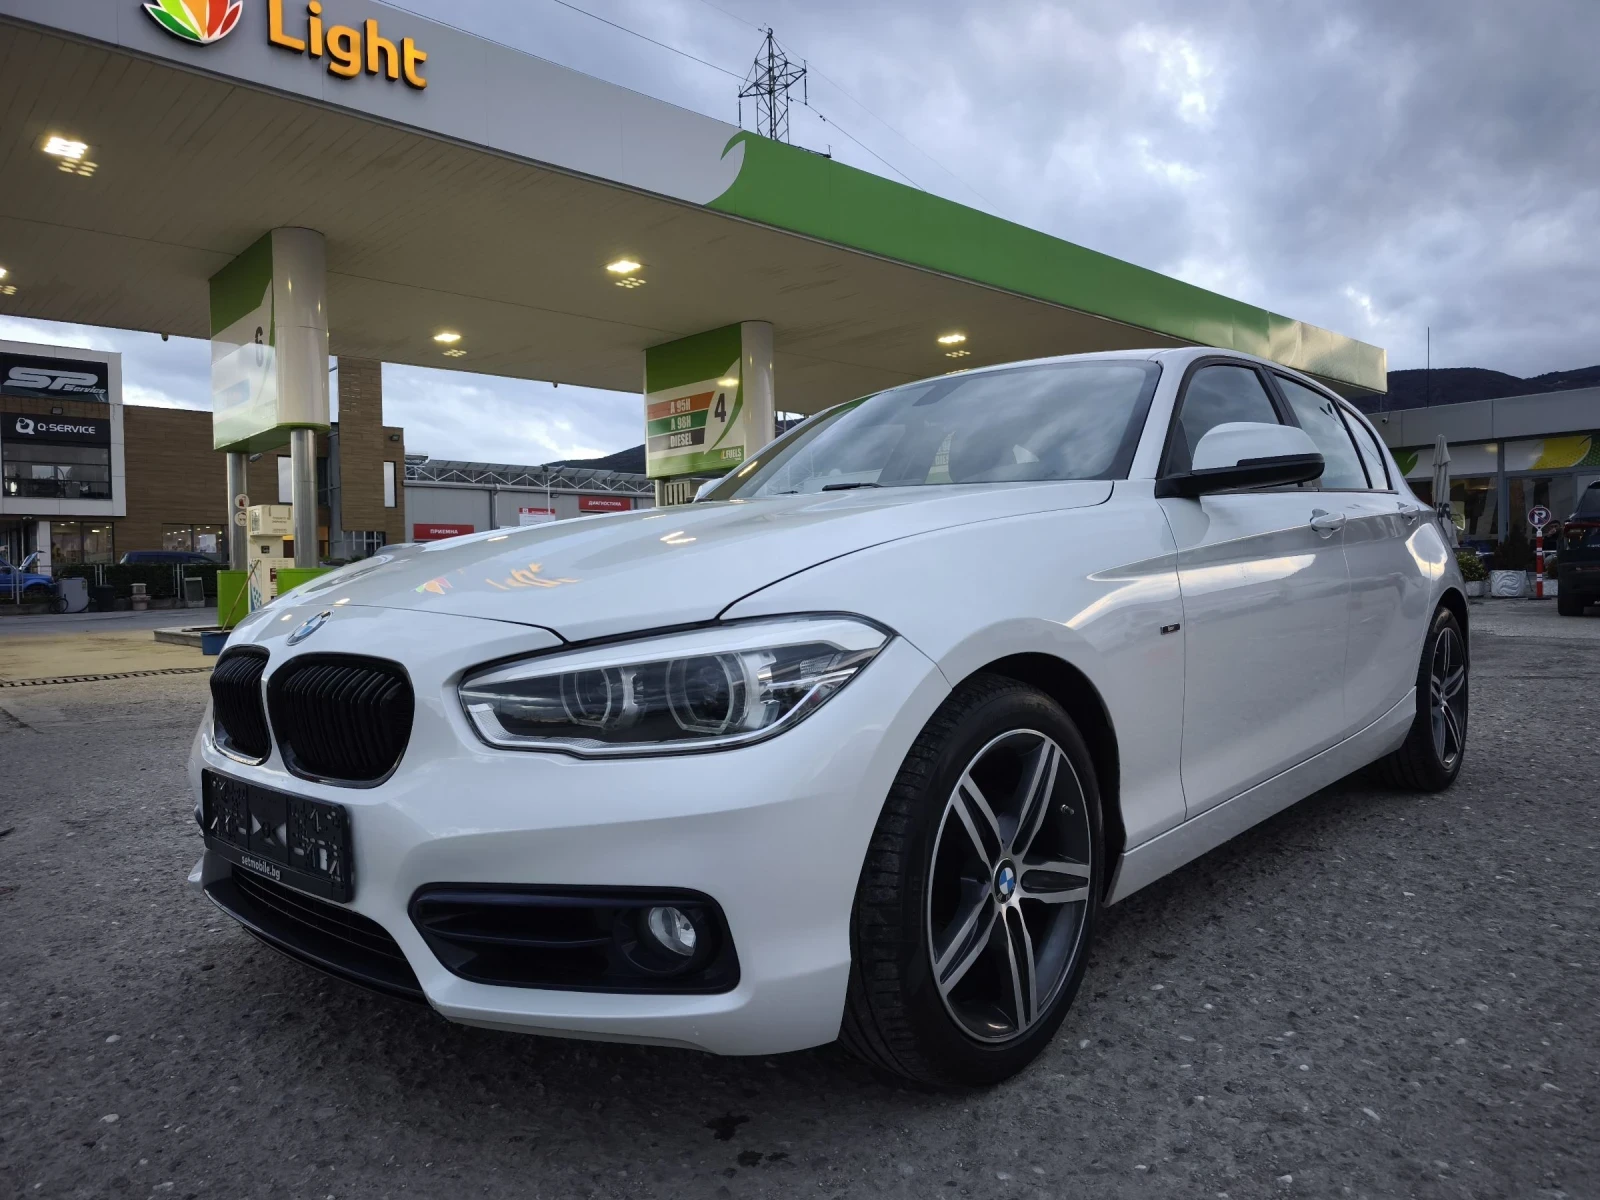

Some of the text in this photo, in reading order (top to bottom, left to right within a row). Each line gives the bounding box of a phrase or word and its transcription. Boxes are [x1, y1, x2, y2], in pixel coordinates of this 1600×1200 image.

[268, 0, 427, 90] Light
[3, 366, 98, 389] SP
[63, 386, 106, 394] Service
[714, 393, 726, 422] 4
[670, 433, 693, 447] DIESEL
[241, 856, 280, 880] setmobile.bg
